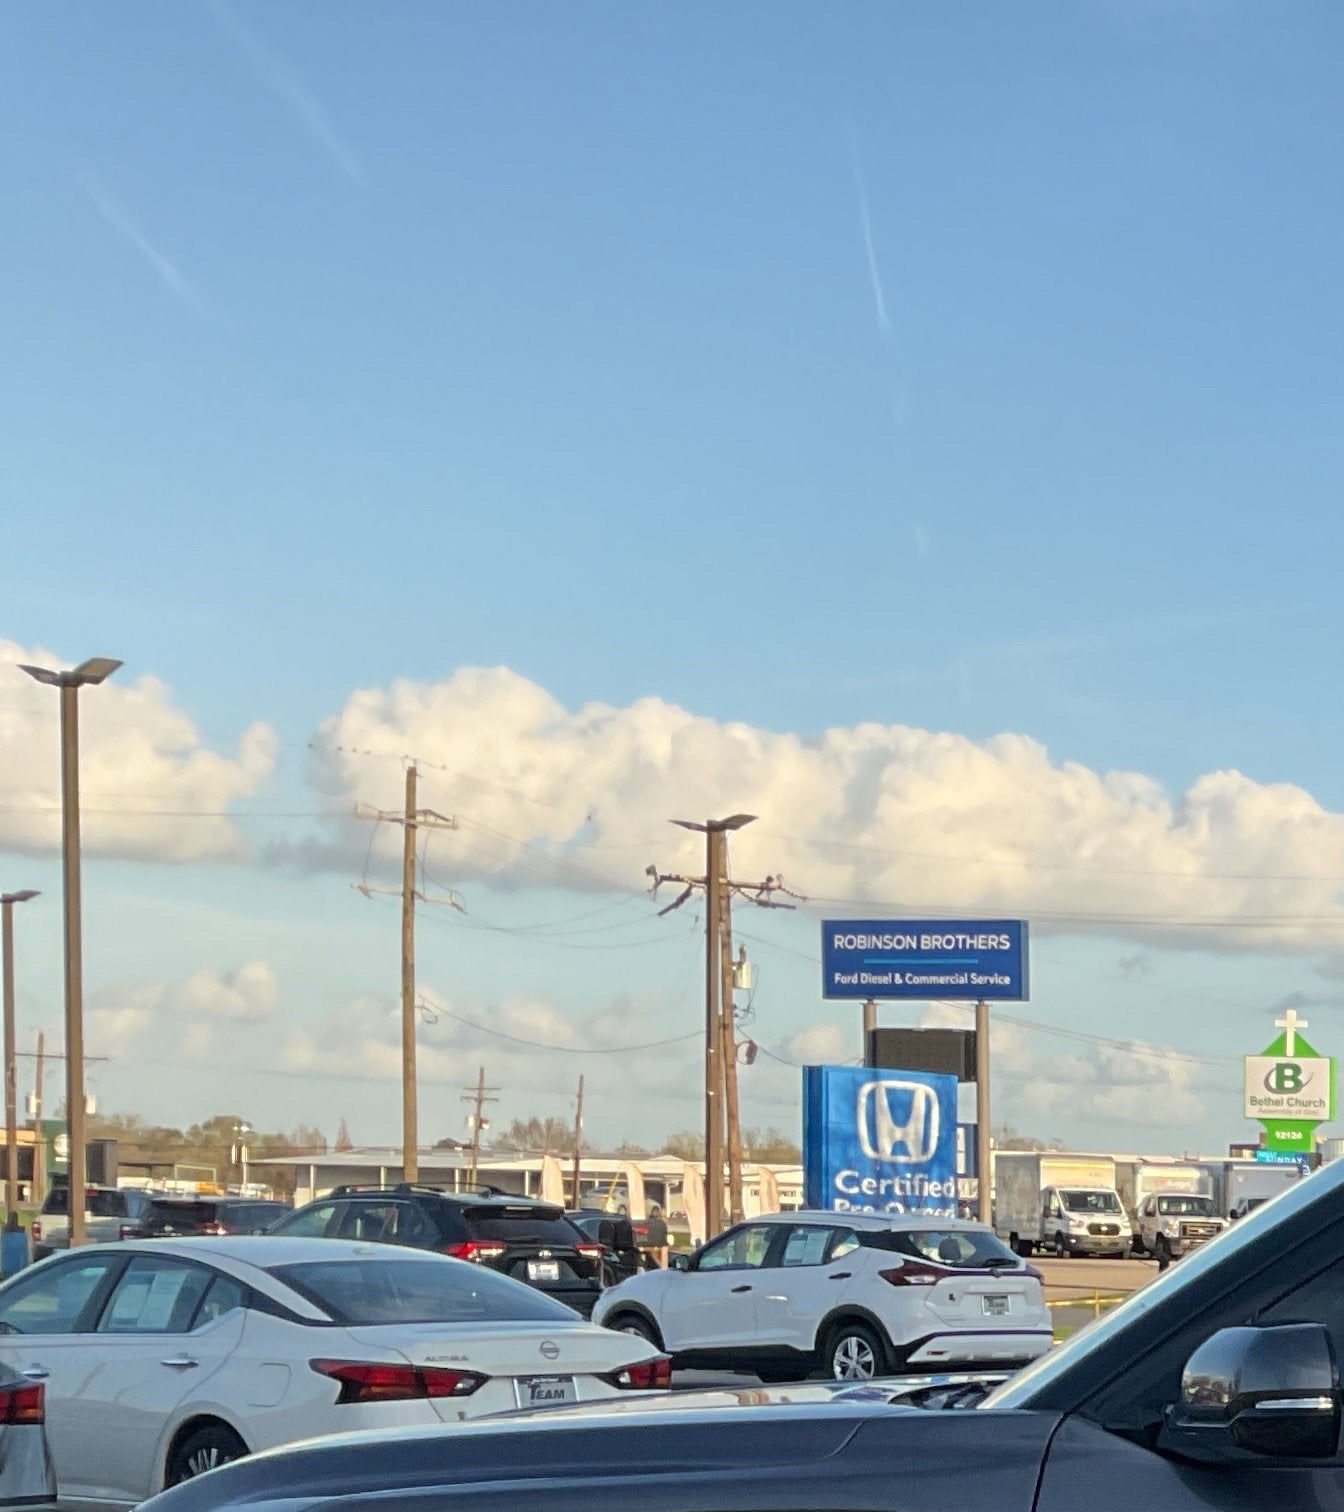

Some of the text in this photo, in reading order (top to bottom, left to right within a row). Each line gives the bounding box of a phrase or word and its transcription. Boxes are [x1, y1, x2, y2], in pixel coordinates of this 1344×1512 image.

[834, 934, 1010, 950] ROBINSON BROTHERS
[834, 973, 1011, 985] Ford Diesel & Commercial Service
[1275, 1063, 1303, 1091] B
[1250, 1096, 1326, 1109] Bethel Church
[835, 1170, 956, 1198] Certified
[528, 1384, 565, 1400] TEAM
